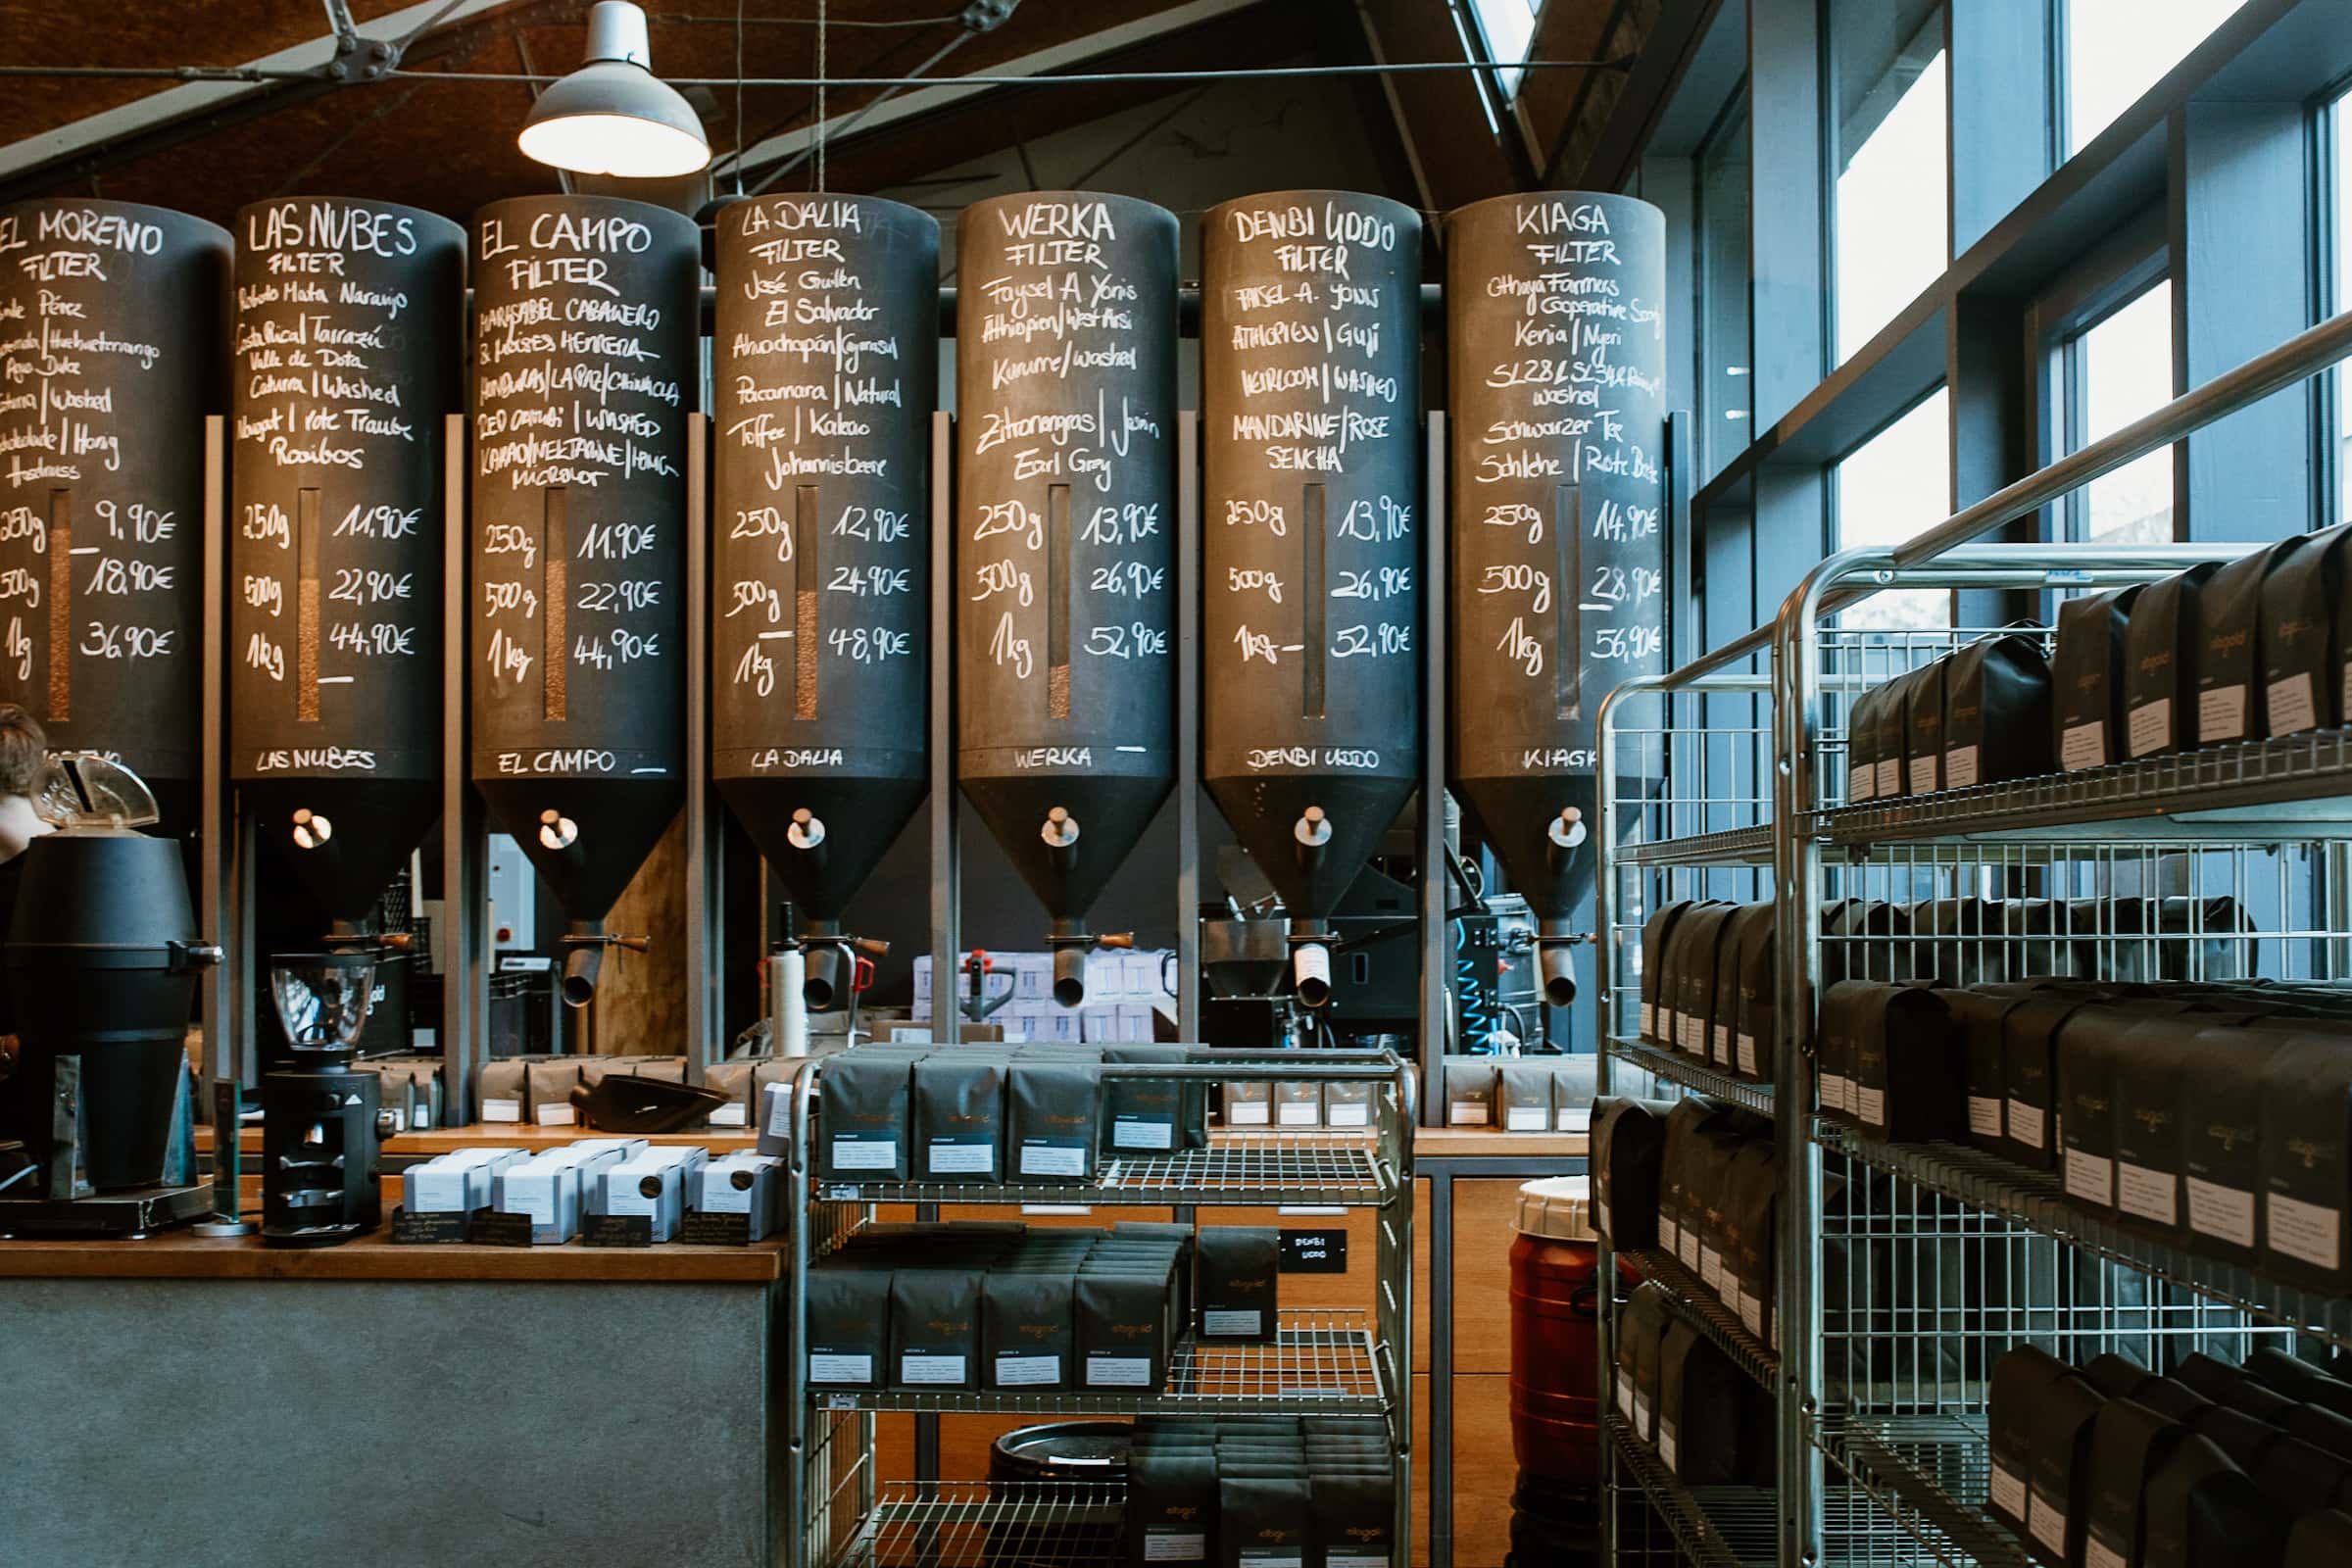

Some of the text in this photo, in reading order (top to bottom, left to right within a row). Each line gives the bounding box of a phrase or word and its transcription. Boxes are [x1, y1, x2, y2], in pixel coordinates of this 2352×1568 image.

[0, 210, 164, 255] EL MORENO
[249, 202, 417, 257] LAS NUBES
[482, 213, 652, 261] EL CAMPO
[742, 201, 861, 237] LA DALIA
[998, 203, 1115, 241] WERKA
[1234, 200, 1396, 252] DENBI UDDO
[1516, 202, 1610, 235] KIAGA
[20, 251, 107, 281] FILTER
[268, 253, 345, 276] FILTER
[749, 238, 846, 265] FILTER
[1004, 241, 1108, 270] FILTER
[1527, 240, 1621, 266] FILTER
[282, 280, 329, 304] Mata
[339, 282, 409, 320] Naranjo
[745, 270, 789, 301] José
[1090, 273, 1138, 309] Yonis
[795, 295, 880, 324] Salvador
[288, 350, 313, 368] de
[315, 349, 368, 370] Dota
[1514, 319, 1622, 368] Kenia Nyeri
[50, 386, 113, 414] Washed
[322, 375, 401, 408] Washed
[736, 375, 903, 409] Pacamara Natural
[1334, 365, 1396, 403] WASHED
[74, 422, 121, 470] Honig
[726, 408, 870, 449] Toffee Kakao
[1483, 410, 1624, 444] Schwarzer Tee
[269, 436, 366, 469] Rooibos
[1013, 448, 1111, 492] Earl Grey
[1265, 445, 1344, 472] SENCHA
[243, 503, 290, 550] 250g
[730, 507, 793, 562] 250g
[831, 505, 910, 542] 12,90€
[973, 500, 1044, 551] 250g
[1080, 503, 1159, 546] 13,90€
[1225, 499, 1287, 537] 250g
[1337, 494, 1411, 543] 13,90€
[1484, 503, 1544, 544] 250g
[1592, 499, 1659, 543] 14,90€
[484, 524, 537, 568] 250g
[328, 568, 413, 606] 22,90€
[576, 580, 663, 614] 22,90€
[827, 565, 910, 597] 24,90€
[972, 559, 1033, 608] 500g
[1091, 561, 1164, 600] 26,90€
[1229, 566, 1284, 604] 500g
[1330, 566, 1411, 601] 26,90€
[1477, 564, 1551, 613] 500g
[485, 582, 538, 618] 500g
[725, 580, 780, 622] 500g
[573, 628, 661, 670] 44,90€
[828, 627, 910, 664] 48,90€
[989, 611, 1032, 679] 1kg
[1083, 621, 1168, 659] 52,90€
[1234, 624, 1279, 664] 1kg
[1330, 622, 1411, 658] 52,90€
[1496, 616, 1544, 677] 1kg
[1591, 625, 1661, 663] 56,90€
[734, 642, 774, 697] 1kg
[256, 746, 376, 771] LAS NUBES
[498, 749, 616, 773] EL CAMPO
[752, 749, 843, 767] LA DALIA
[1014, 747, 1093, 769] WERKA
[1247, 748, 1380, 768] DENBI UDDO
